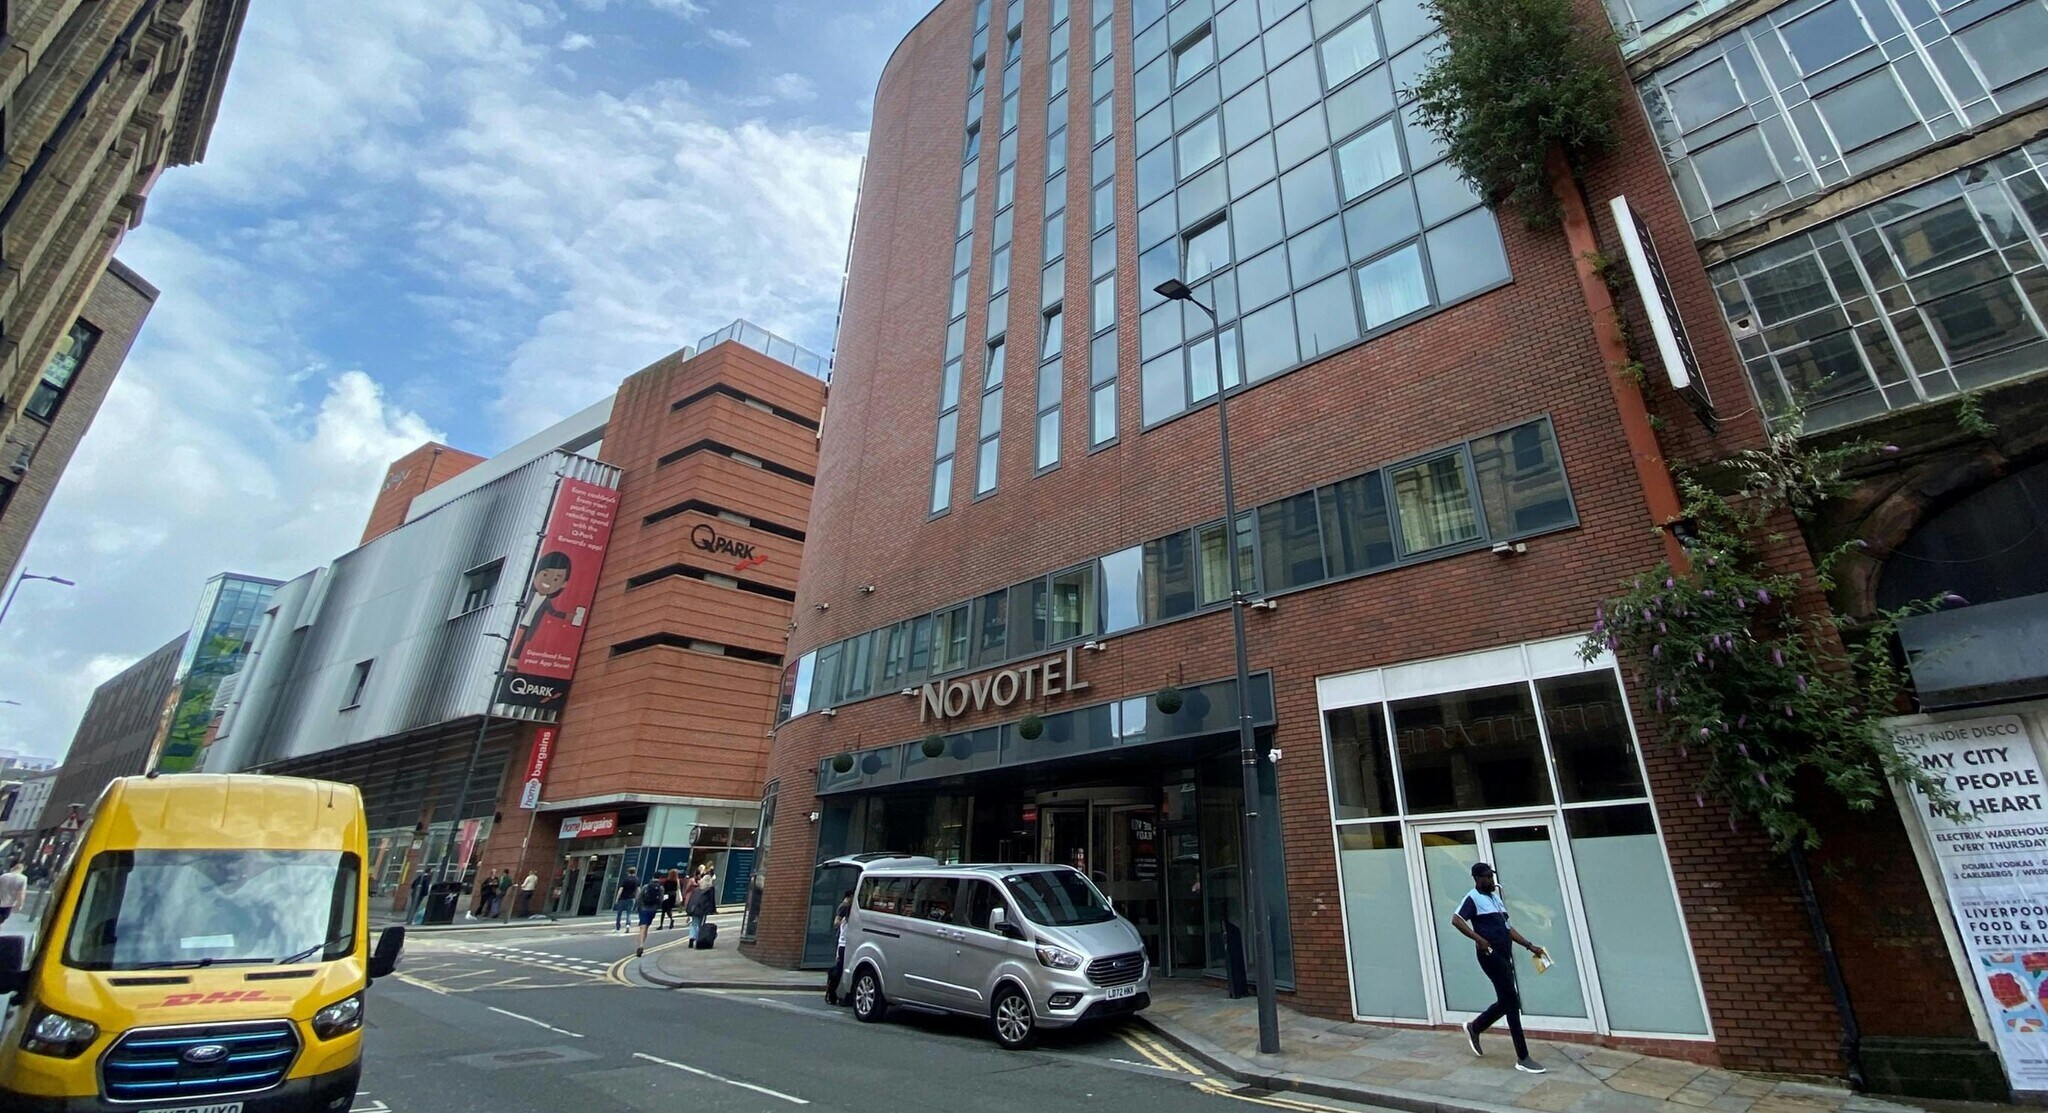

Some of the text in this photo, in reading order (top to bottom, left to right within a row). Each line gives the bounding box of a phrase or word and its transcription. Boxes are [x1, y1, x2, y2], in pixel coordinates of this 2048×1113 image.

[571, 487, 616, 504] Earn cashback
[576, 496, 592, 505] from
[570, 505, 609, 519] parking and
[558, 535, 586, 547] Rewards
[526, 649, 572, 661] Download from
[540, 660, 552, 668] App
[920, 648, 1089, 723] NOVOTEL
[1897, 723, 2019, 746] SHT INDIE DISCO
[1921, 747, 2009, 770] MY CITY
[525, 731, 551, 807] home bargains
[1955, 769, 2039, 791] PEOPLE
[1969, 794, 2043, 814] HEART
[582, 817, 613, 832] bargains
[1936, 831, 1983, 842] ELECTRIK
[1953, 838, 2047, 852] EVERY THURSDAY
[1961, 862, 1995, 870] DOUBLE
[1996, 860, 2034, 868] VODKAS
[1961, 870, 2013, 879] CARLSBERGS
[1970, 921, 2013, 932] FOOD
[2020, 920, 2031, 930] &
[1974, 933, 2048, 945] FESTIVAL
[161, 990, 272, 1007] DHL
